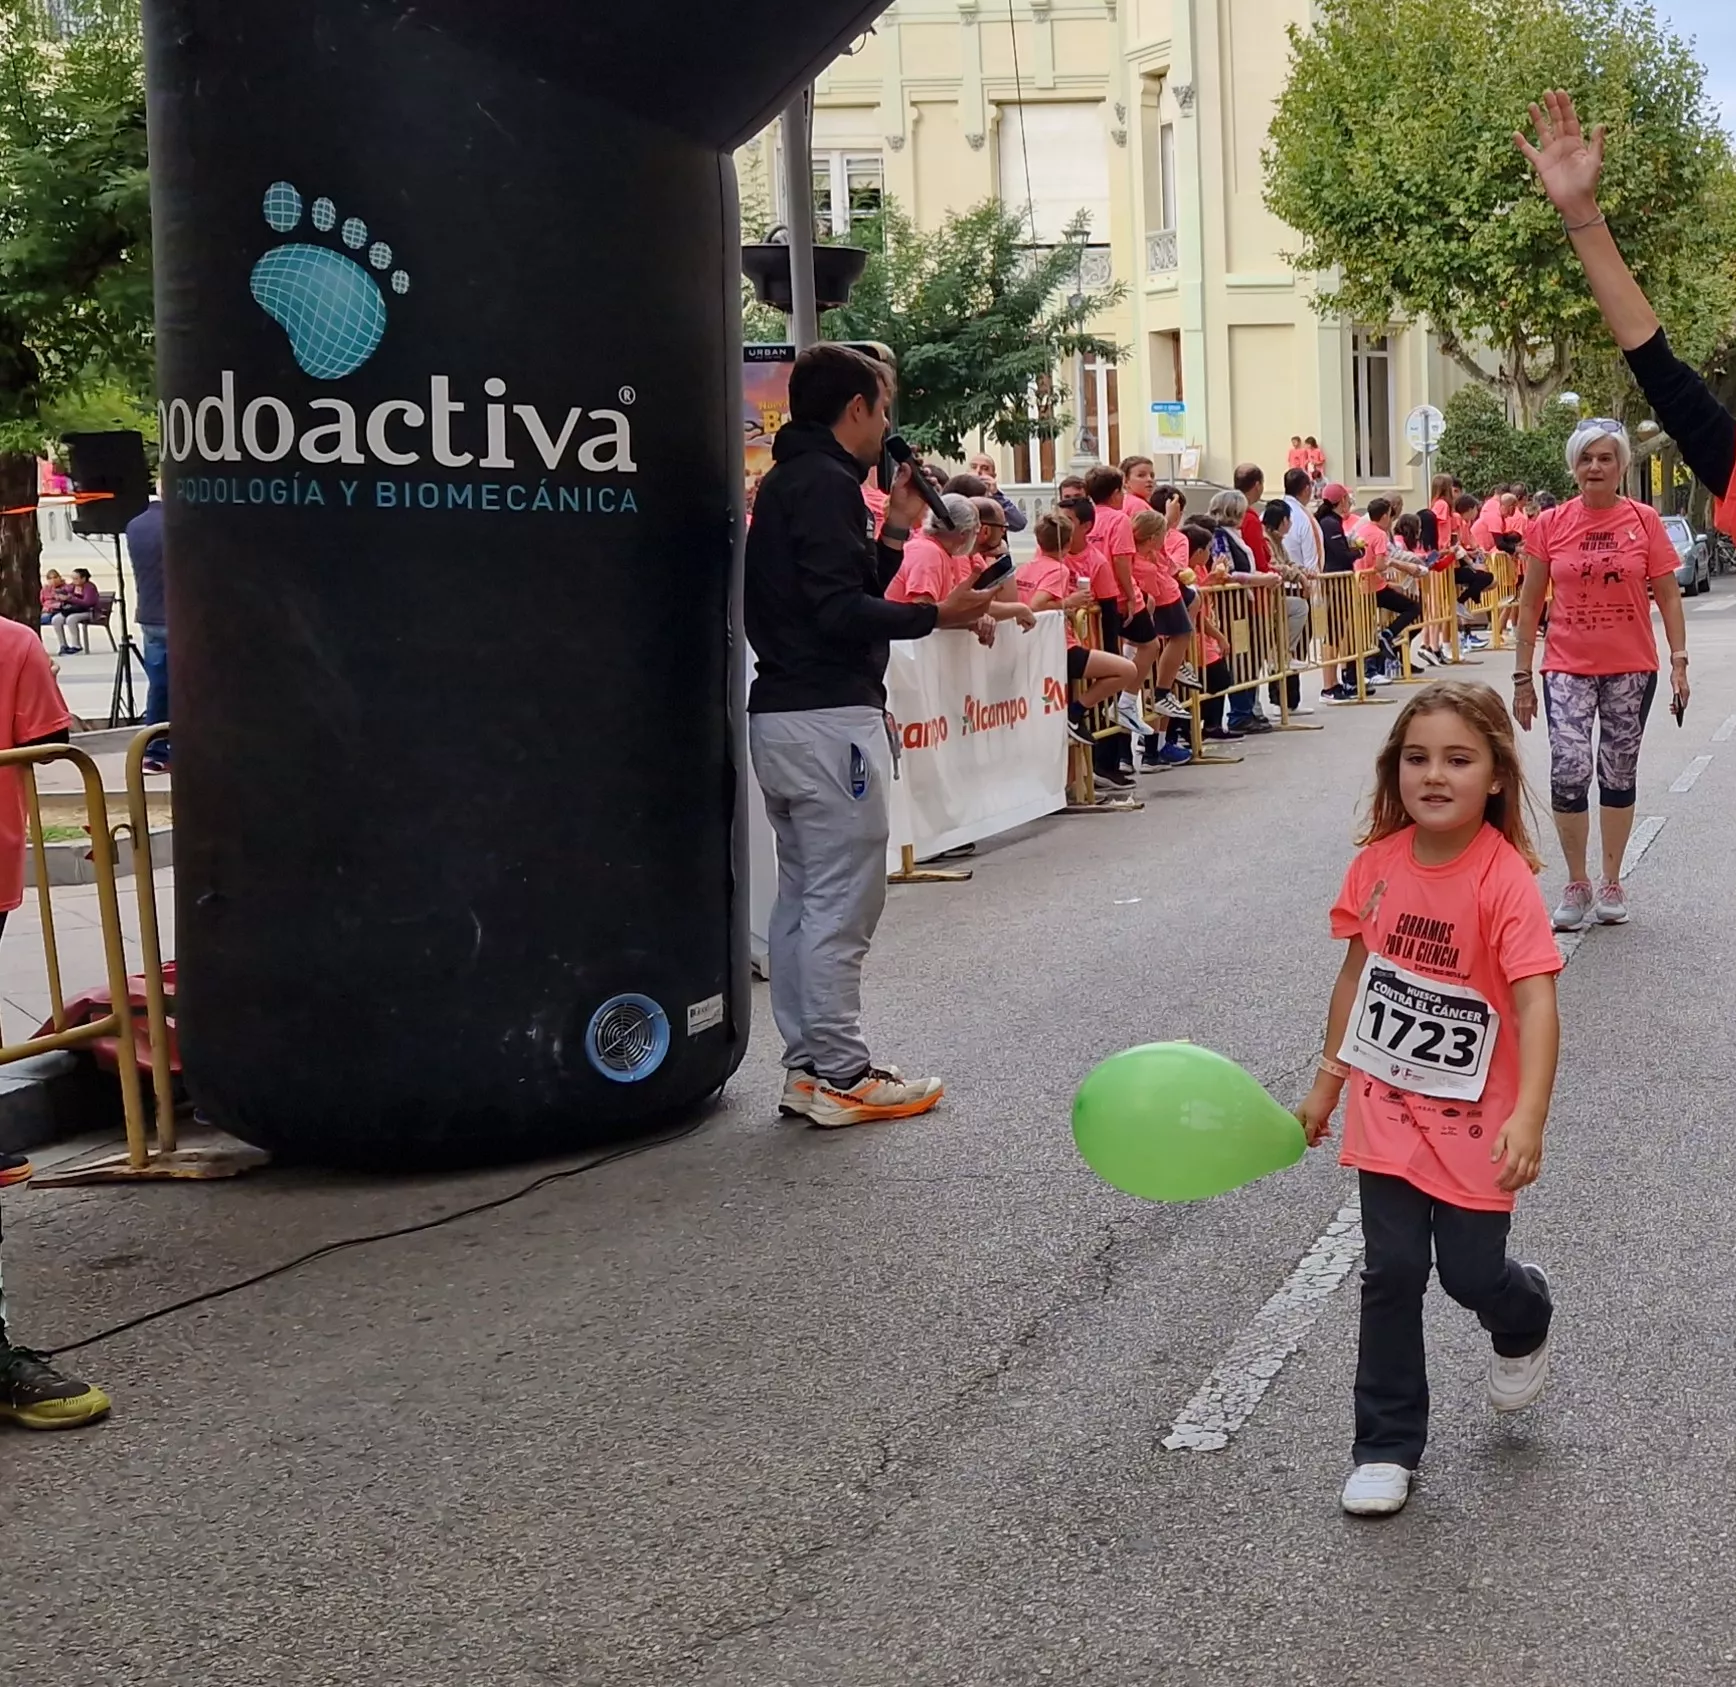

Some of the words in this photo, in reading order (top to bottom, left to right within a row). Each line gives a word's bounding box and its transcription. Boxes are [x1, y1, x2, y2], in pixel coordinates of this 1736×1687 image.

[748, 348, 787, 356] URBAN
[176, 471, 326, 506] PODOLOGÍA
[339, 480, 359, 507] Y
[376, 478, 638, 513] BIOMECÁNICA
[962, 694, 1028, 736] Alcampo
[1396, 912, 1455, 945] CORRAMOS
[1402, 940, 1415, 960] LA
[1415, 941, 1460, 969] CIENCIA
[1373, 980, 1413, 1008] CONTRA
[1415, 999, 1429, 1012] EL
[1432, 1004, 1482, 1023] CÁNCER
[1406, 986, 1442, 1004] HUESCA
[1368, 1000, 1478, 1068] 1723
